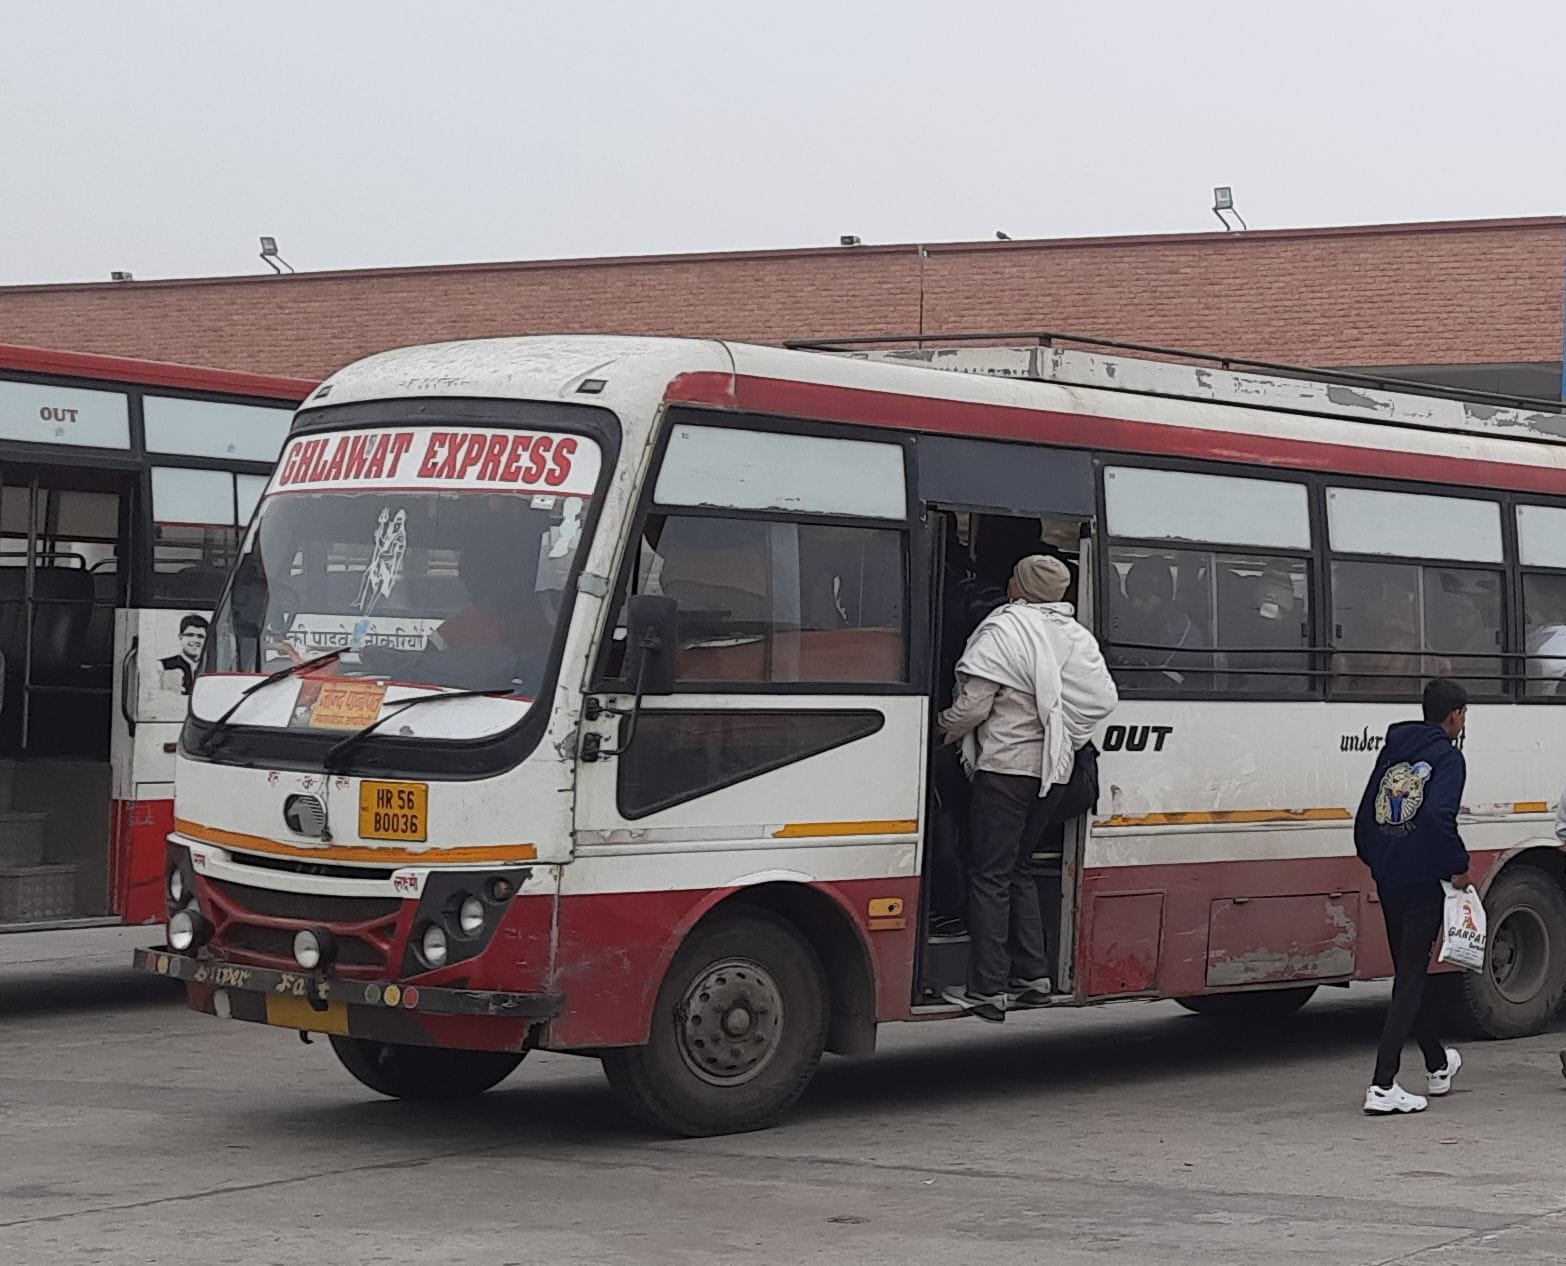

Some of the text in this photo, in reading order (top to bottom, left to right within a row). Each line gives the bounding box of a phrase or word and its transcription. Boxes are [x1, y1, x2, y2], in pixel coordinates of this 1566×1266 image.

[40, 406, 78, 422] OUT
[416, 432, 578, 487] EXPRESS
[1102, 725, 1174, 752] OUT
[1340, 725, 1384, 752] under
[376, 788, 415, 810] HR 56
[275, 972, 331, 999] Fat
